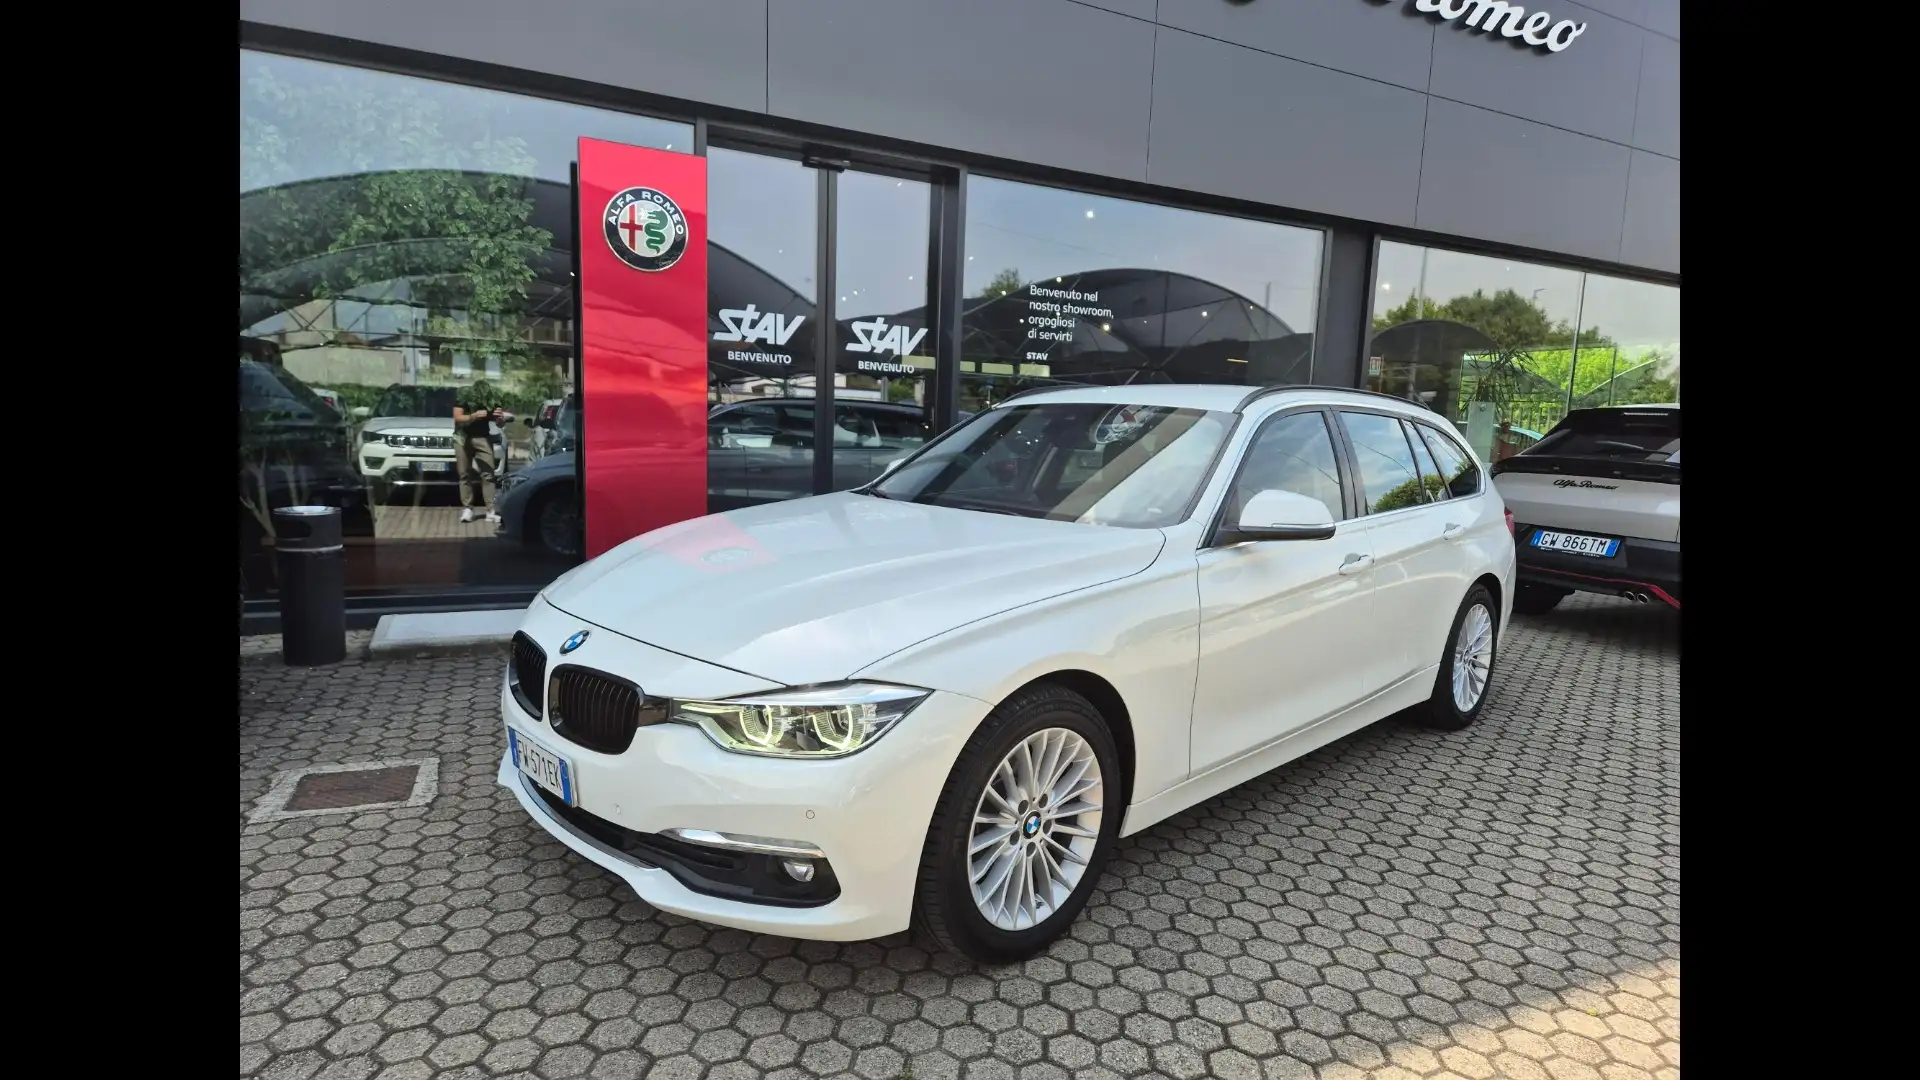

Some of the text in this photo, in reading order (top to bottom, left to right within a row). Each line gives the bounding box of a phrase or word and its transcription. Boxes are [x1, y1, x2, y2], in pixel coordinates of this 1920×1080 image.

[1416, 0, 1587, 52] omeo
[608, 190, 684, 235] ALFA ROMEO
[1030, 284, 1099, 302] Benvenuto nel
[1029, 301, 1115, 319] nostro showroom,
[1028, 315, 1076, 329] orgogliosi
[1027, 328, 1073, 342] di servirti
[727, 350, 792, 365] BENVENUTO
[1026, 351, 1049, 361] STAV
[858, 360, 915, 375] BENVENUTO
[1562, 535, 1608, 553] 866TM
